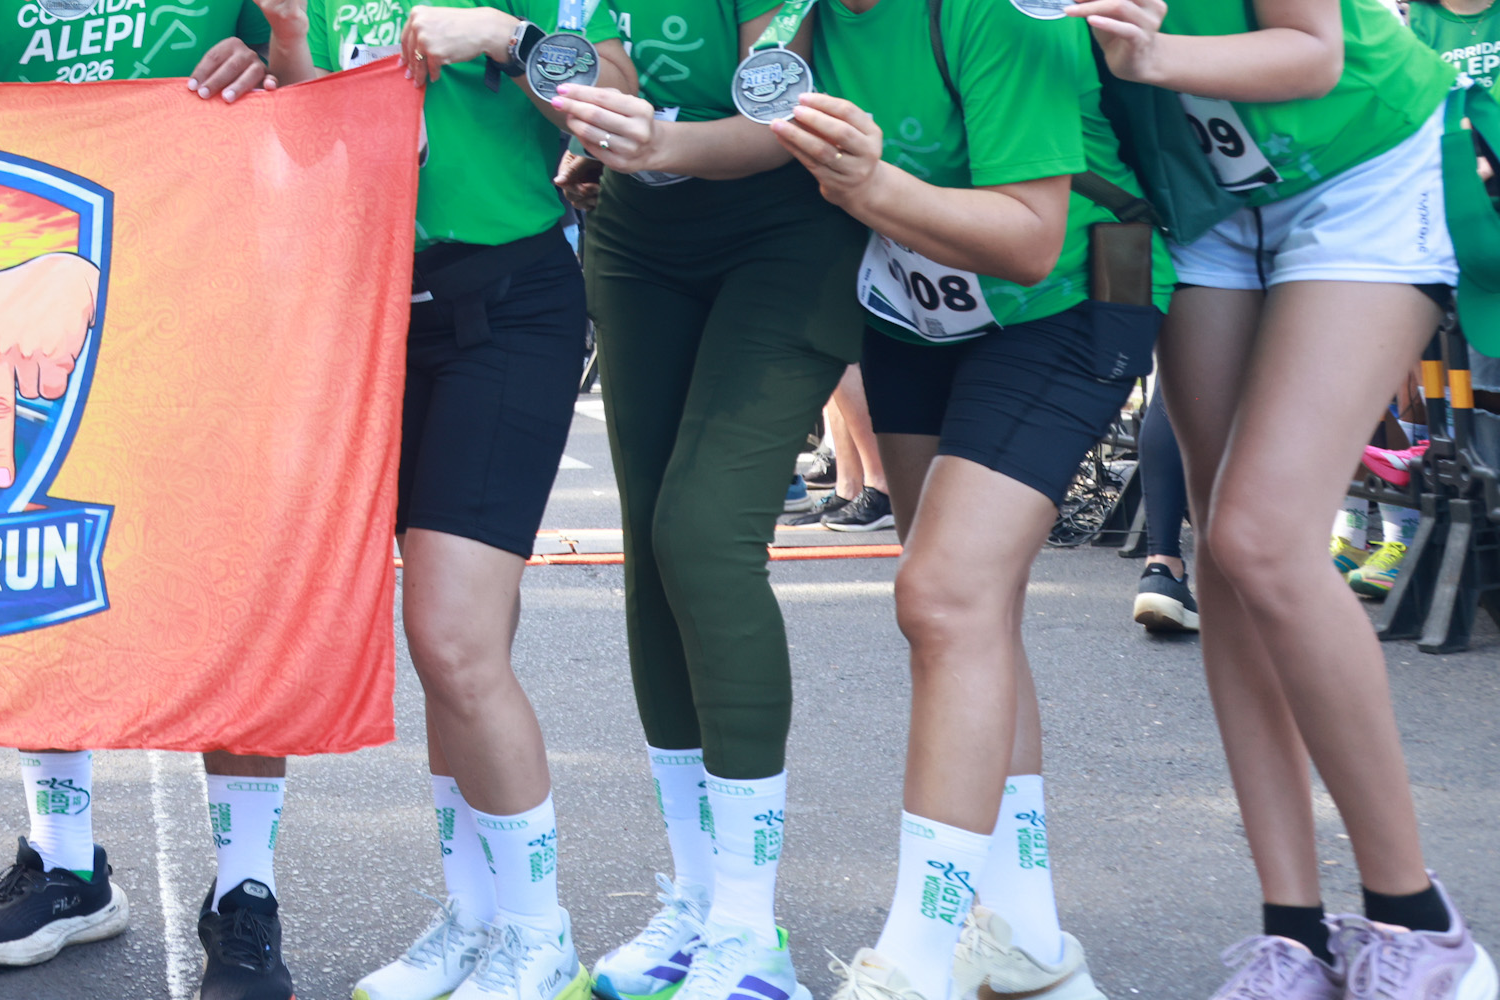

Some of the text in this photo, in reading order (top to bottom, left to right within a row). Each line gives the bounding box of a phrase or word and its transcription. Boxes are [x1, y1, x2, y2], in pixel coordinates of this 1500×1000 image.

[19, 12, 146, 65] ALEPI
[55, 59, 114, 84] 2026
[1033, 828, 1049, 870] ALEPI
[920, 874, 942, 919] CORRIDA
[938, 879, 963, 925] ALEPI
